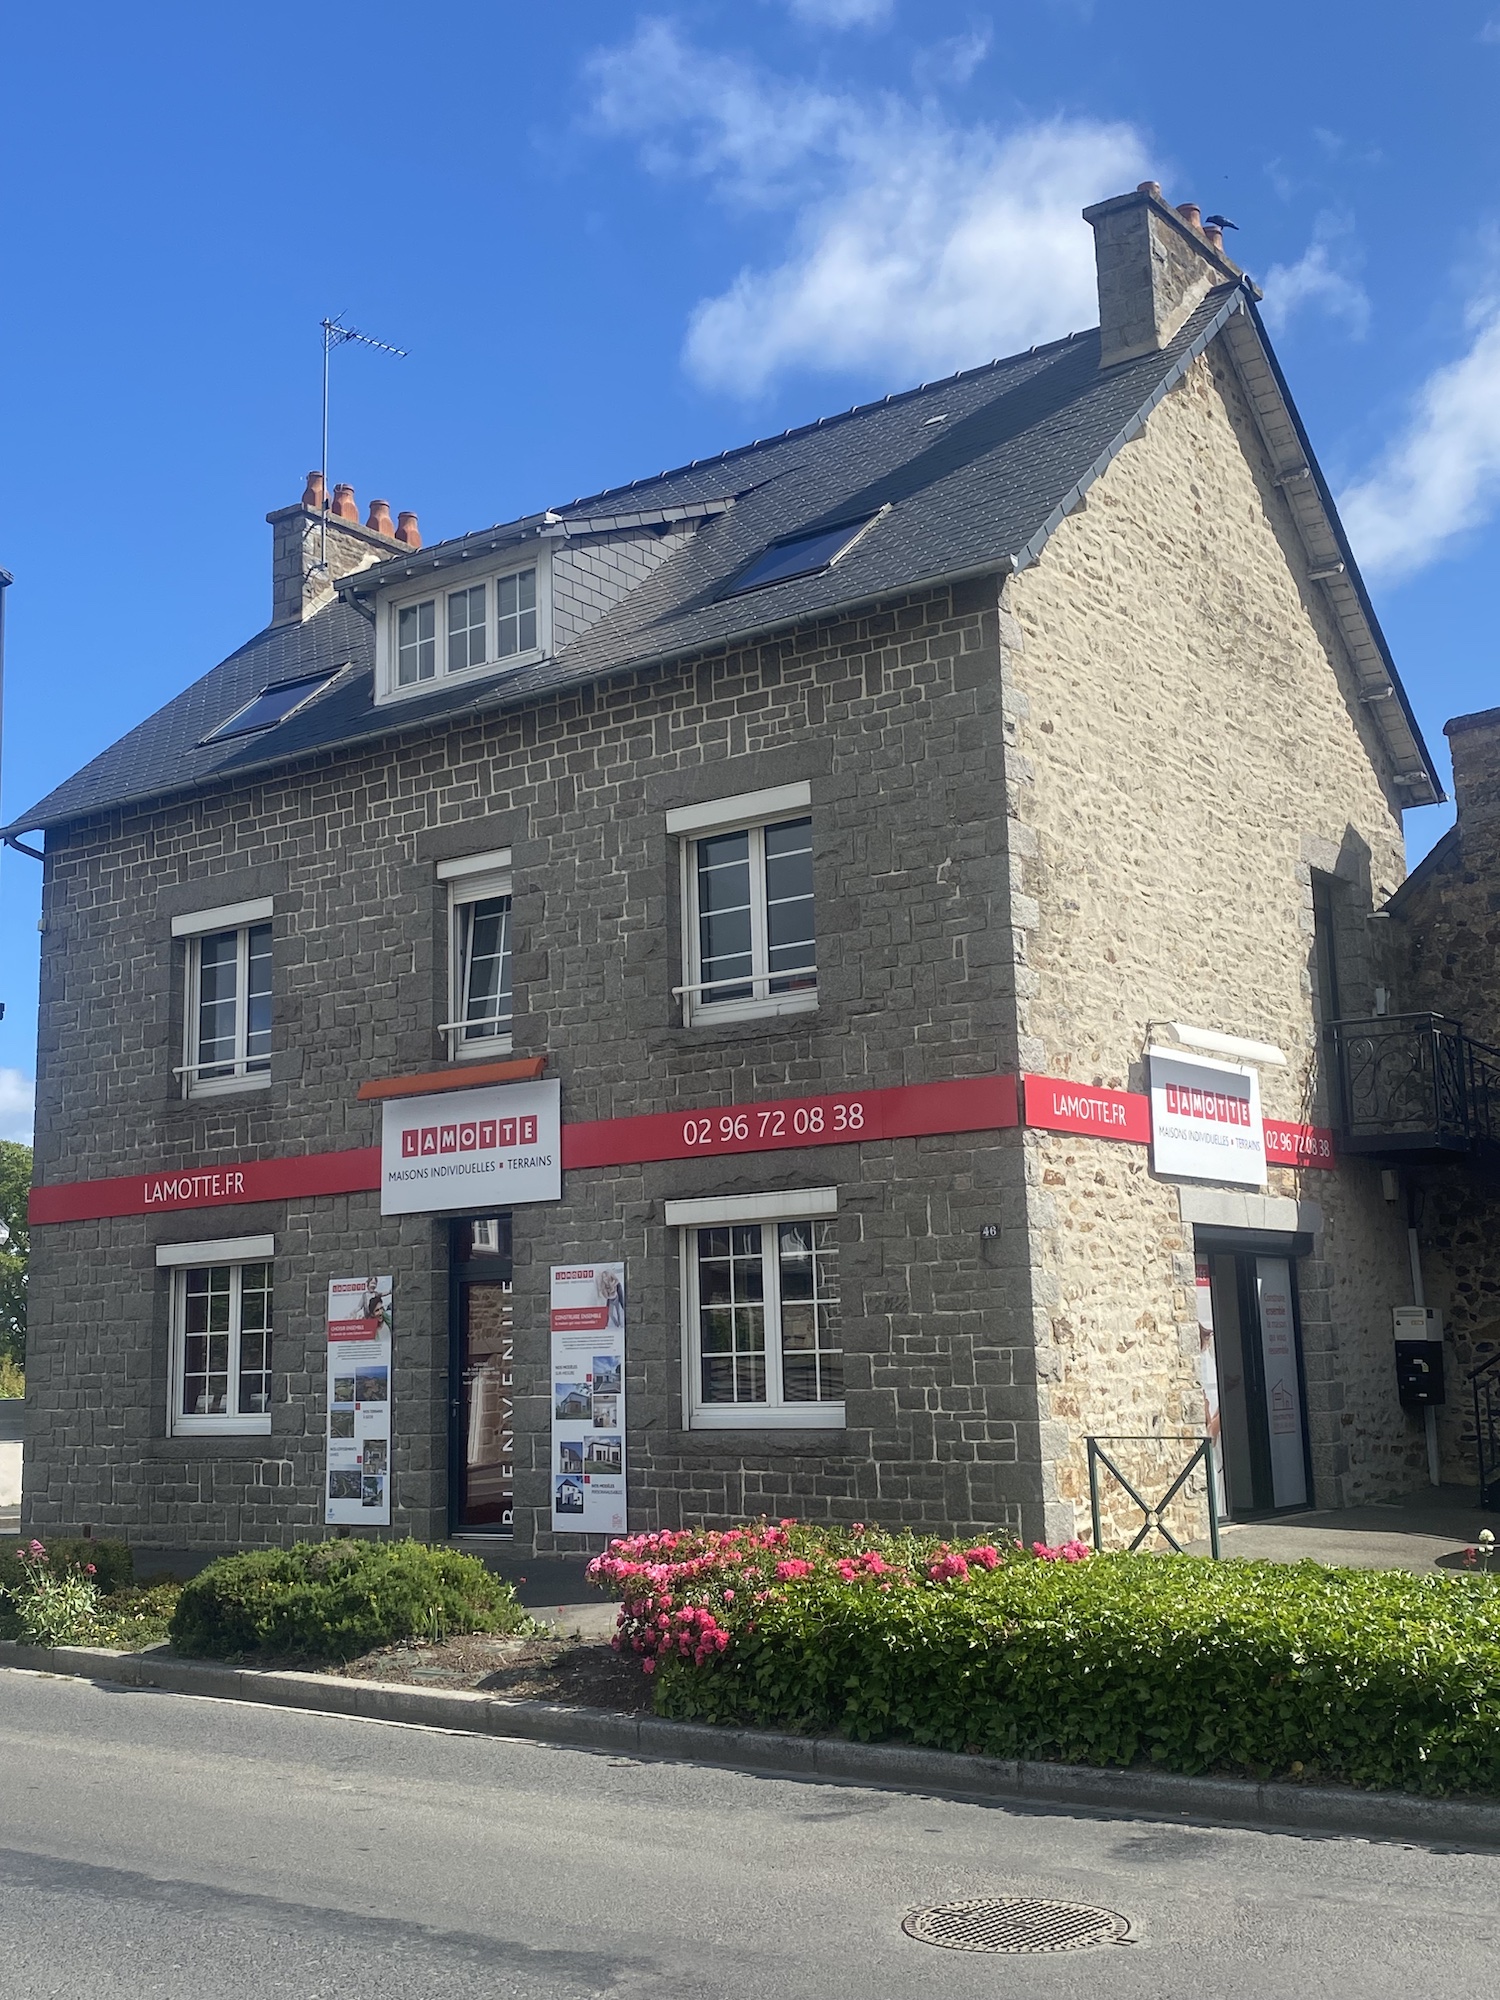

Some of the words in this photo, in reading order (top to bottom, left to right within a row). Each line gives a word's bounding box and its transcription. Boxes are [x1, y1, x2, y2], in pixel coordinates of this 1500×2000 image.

[1053, 1093, 1127, 1126] LAMOTTE.FR
[1168, 1087, 1249, 1124] LAMOTTE
[405, 1120, 535, 1154] LAMOTTE
[683, 1118, 712, 1145] 02
[719, 1114, 749, 1142] 96
[757, 1110, 786, 1138] 72
[793, 1106, 825, 1135] 08
[833, 1103, 865, 1131] 38
[1158, 1126, 1188, 1141] MAISONS
[1188, 1130, 1229, 1147] INDIVIDUELLES
[1235, 1137, 1261, 1152] TERRAINS
[1266, 1130, 1279, 1149] 02
[1280, 1132, 1292, 1152] 96
[1293, 1134, 1305, 1153] 72
[1305, 1136, 1318, 1156] 08
[1319, 1139, 1330, 1158] 38
[388, 1167, 429, 1182] MAISONS
[430, 1161, 496, 1178] INDIVIDUELLES
[507, 1155, 552, 1170] TERRAINS
[144, 1172, 244, 1203] LAMOTTE.FR
[982, 1225, 997, 1237] 46
